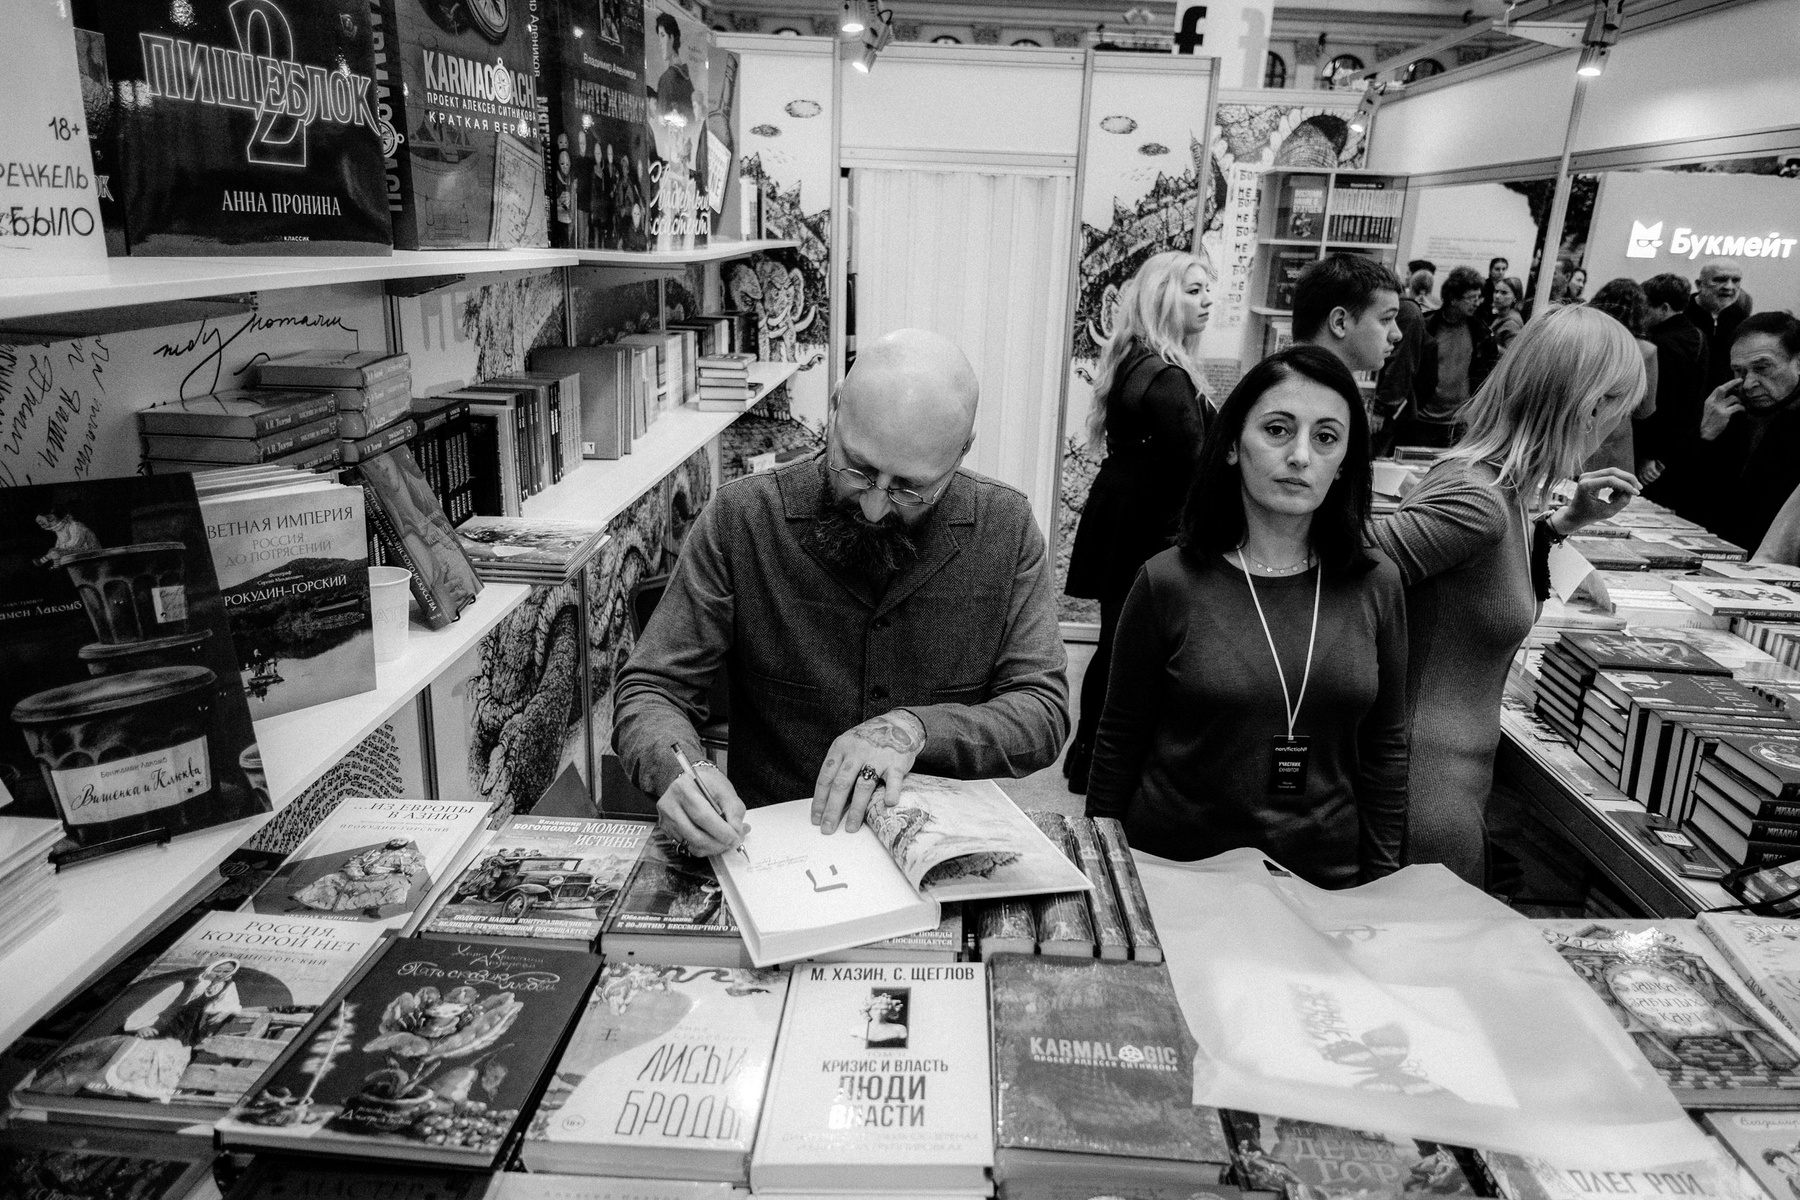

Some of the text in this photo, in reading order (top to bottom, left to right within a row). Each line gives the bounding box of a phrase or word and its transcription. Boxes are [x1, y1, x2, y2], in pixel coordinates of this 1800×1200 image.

[529, 14, 541, 78] Алеников
[139, 32, 381, 136] ПИЩЕБЛОК
[427, 92, 536, 121] ПРОЕКТ АЛЕКСЕЯ СИТНИКОВА
[48, 116, 81, 141] 18+
[429, 111, 489, 131] КРАТКАЯ
[222, 189, 342, 216] АННА ПРОНИНА
[1669, 227, 1798, 260] Букмейт
[207, 506, 353, 540] ВЕТНАЯ ИМПЕРИЯ
[224, 540, 332, 568] ДО ПОТРЯСЕНИЙ
[252, 532, 304, 550] РОССИЯ
[223, 575, 347, 606] РОКУДИН-ГОРСКИЙ
[413, 571, 438, 612] ИСКУССТВА
[71, 783, 142, 810] Вишенка
[151, 756, 201, 791] Клюква
[387, 811, 460, 821] В АЗИЮ
[399, 803, 475, 814] ЕВРОПЫ
[513, 823, 579, 833] БОГОМОЛОВ
[574, 834, 641, 849] ИСТИНЫ
[538, 818, 648, 836] Владимир МОМЕНТ
[454, 913, 593, 928] ПОДВИГУ НАШИХ КОНТРРАЗВЕДЧИКОВ
[473, 921, 534, 932] ОТЕЧЕСТВЕННОЙ
[534, 924, 588, 935] ПОСВЯЩАЕТСЯ
[667, 923, 728, 932] БЕССМЕРТНОГО
[200, 930, 311, 949] КОТОРОЙ
[313, 938, 361, 952] НЕТ
[892, 938, 953, 946] ПОСВЯЩАЕТСЯ
[810, 967, 975, 982] М. ХАЗИН, С. ЩЕГЛОВ
[636, 1043, 747, 1084] ЛИСЬИ
[821, 1059, 949, 1073] КРИЗИС И ВЛАСТЬ
[1034, 1054, 1178, 1072] ПРОЕКТ АЛЕКСЕЯ СИТНИКОВА
[839, 1075, 926, 1103] ЛЮДИ
[614, 1089, 742, 1140] БРОДЫ
[1566, 1169, 1706, 1196] ОЛЕГ РОЙ
